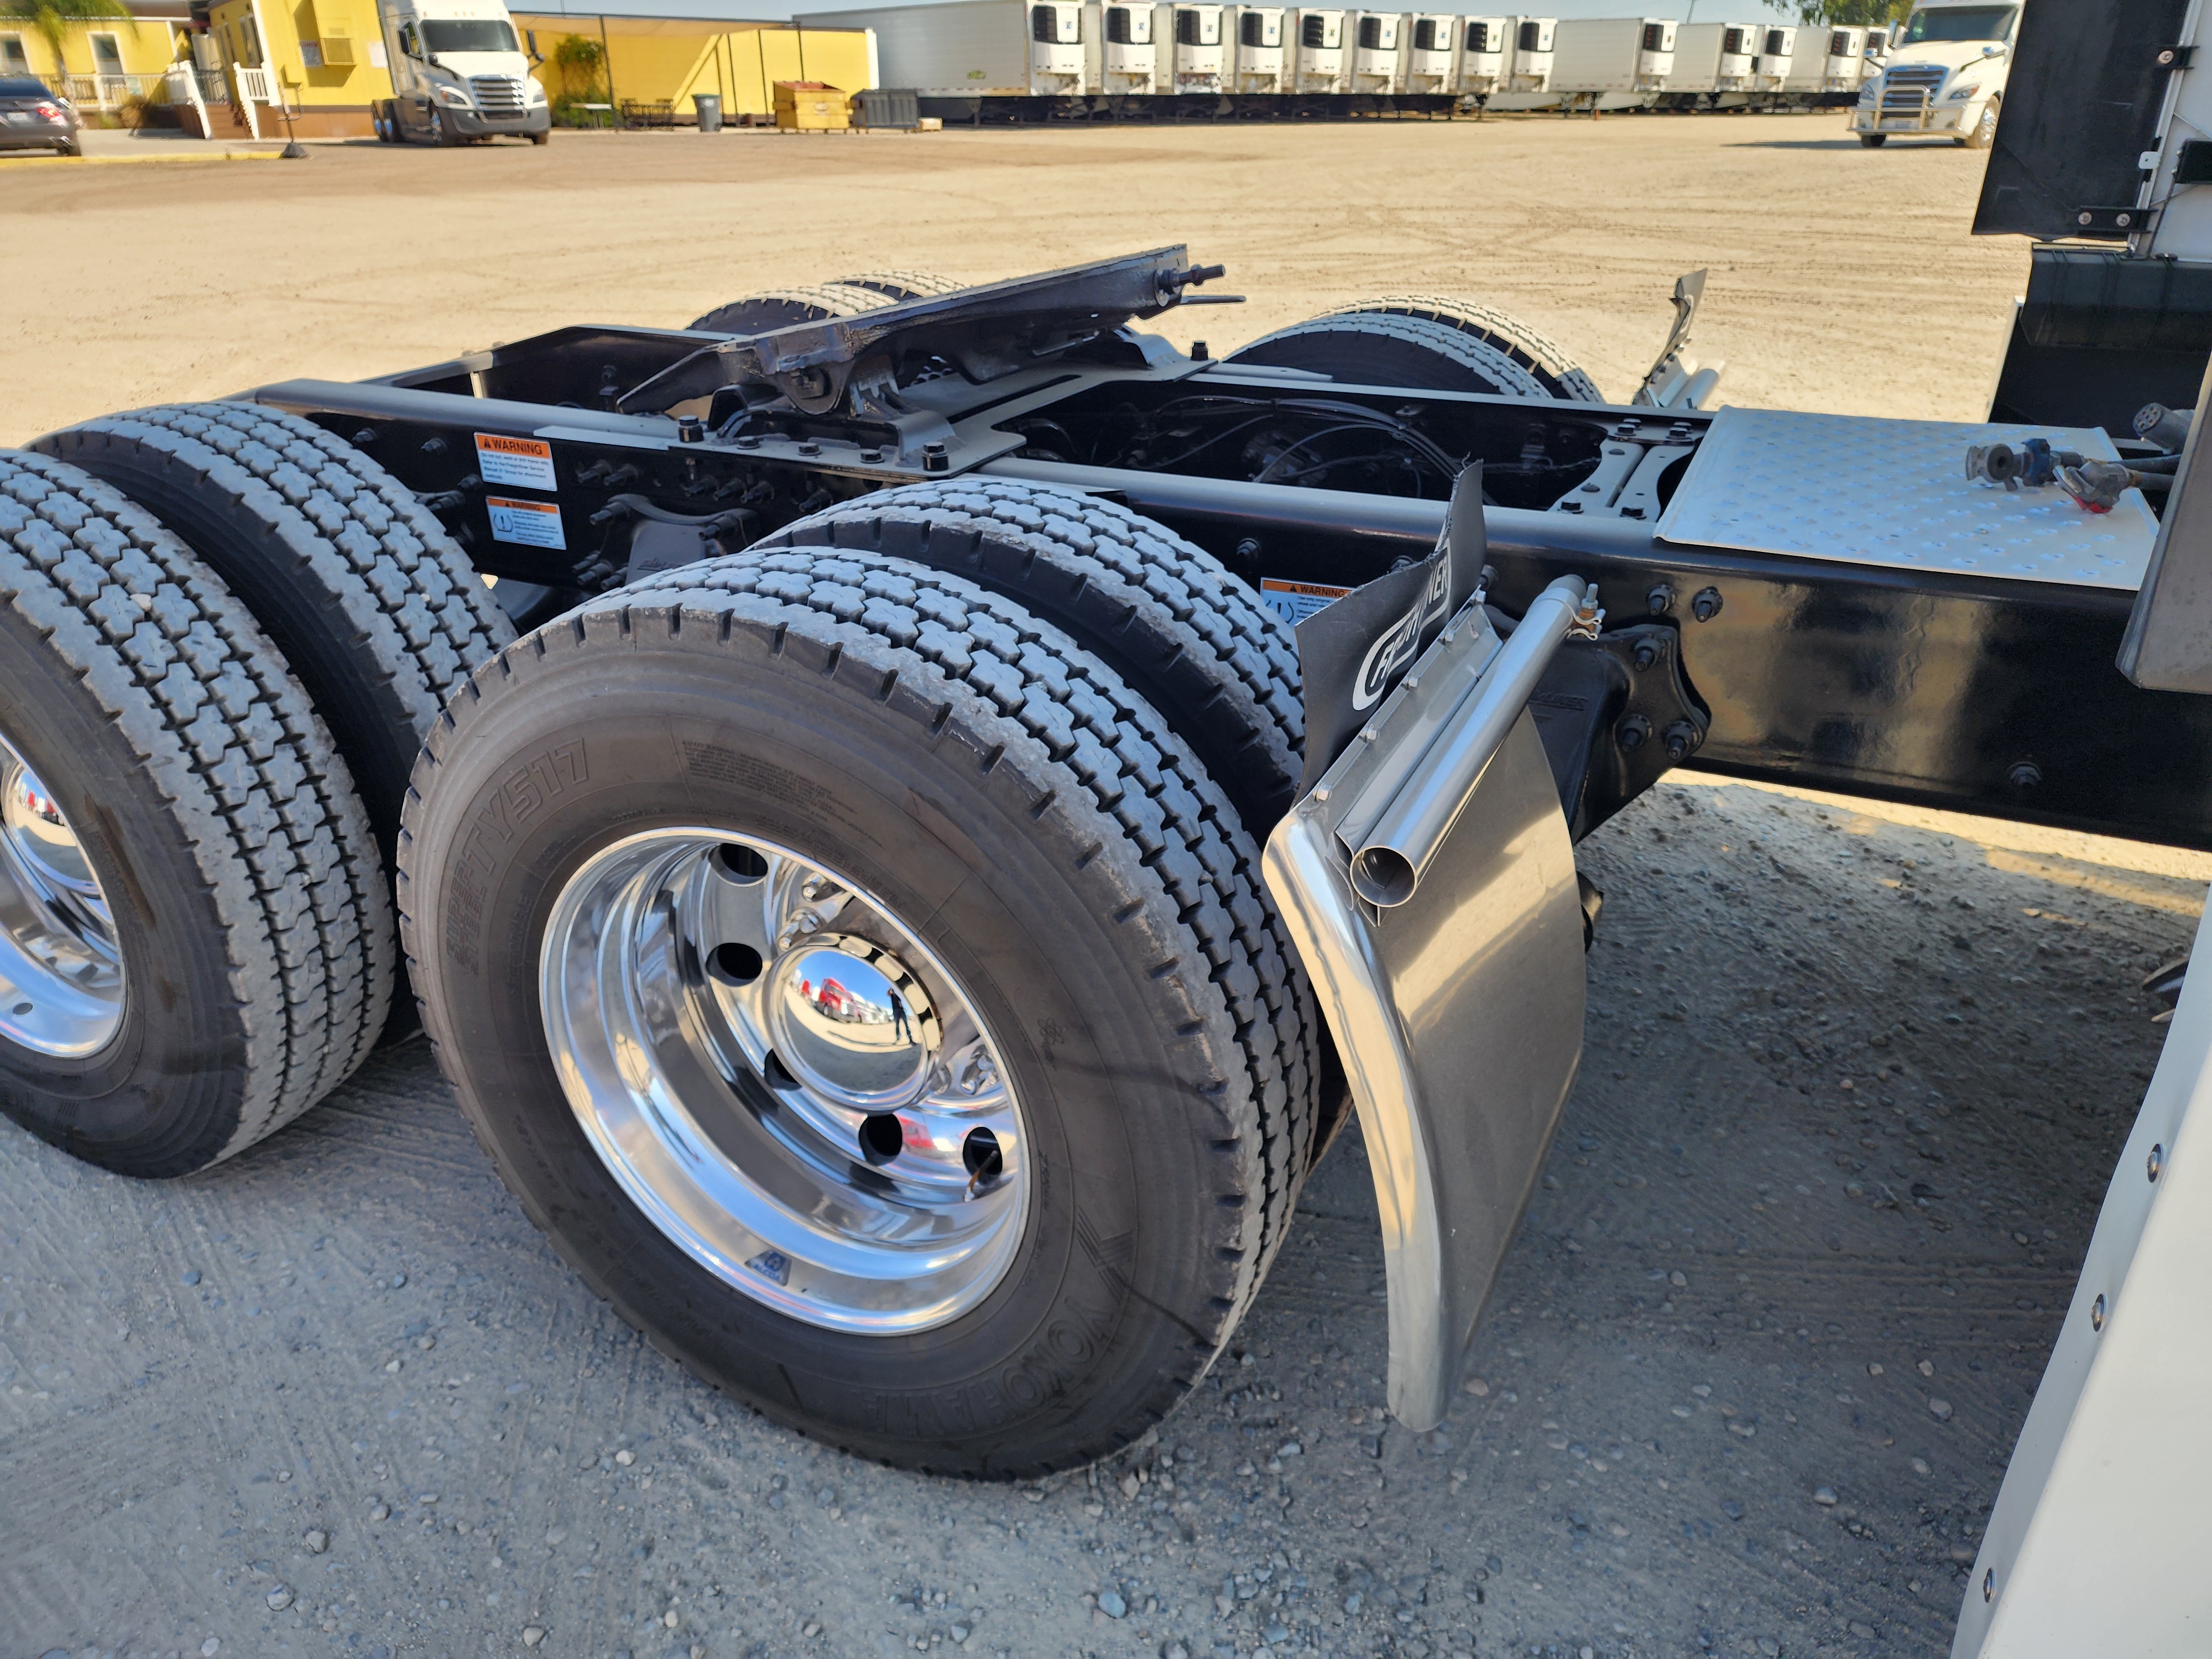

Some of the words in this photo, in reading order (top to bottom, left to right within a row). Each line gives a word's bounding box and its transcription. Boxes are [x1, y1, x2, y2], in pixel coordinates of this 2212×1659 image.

[492, 439, 542, 455] WARNING
[1300, 586, 1345, 598] WARNING
[462, 737, 589, 875] TY517
[446, 859, 473, 960] SUPER
[461, 885, 487, 977] STEEL
